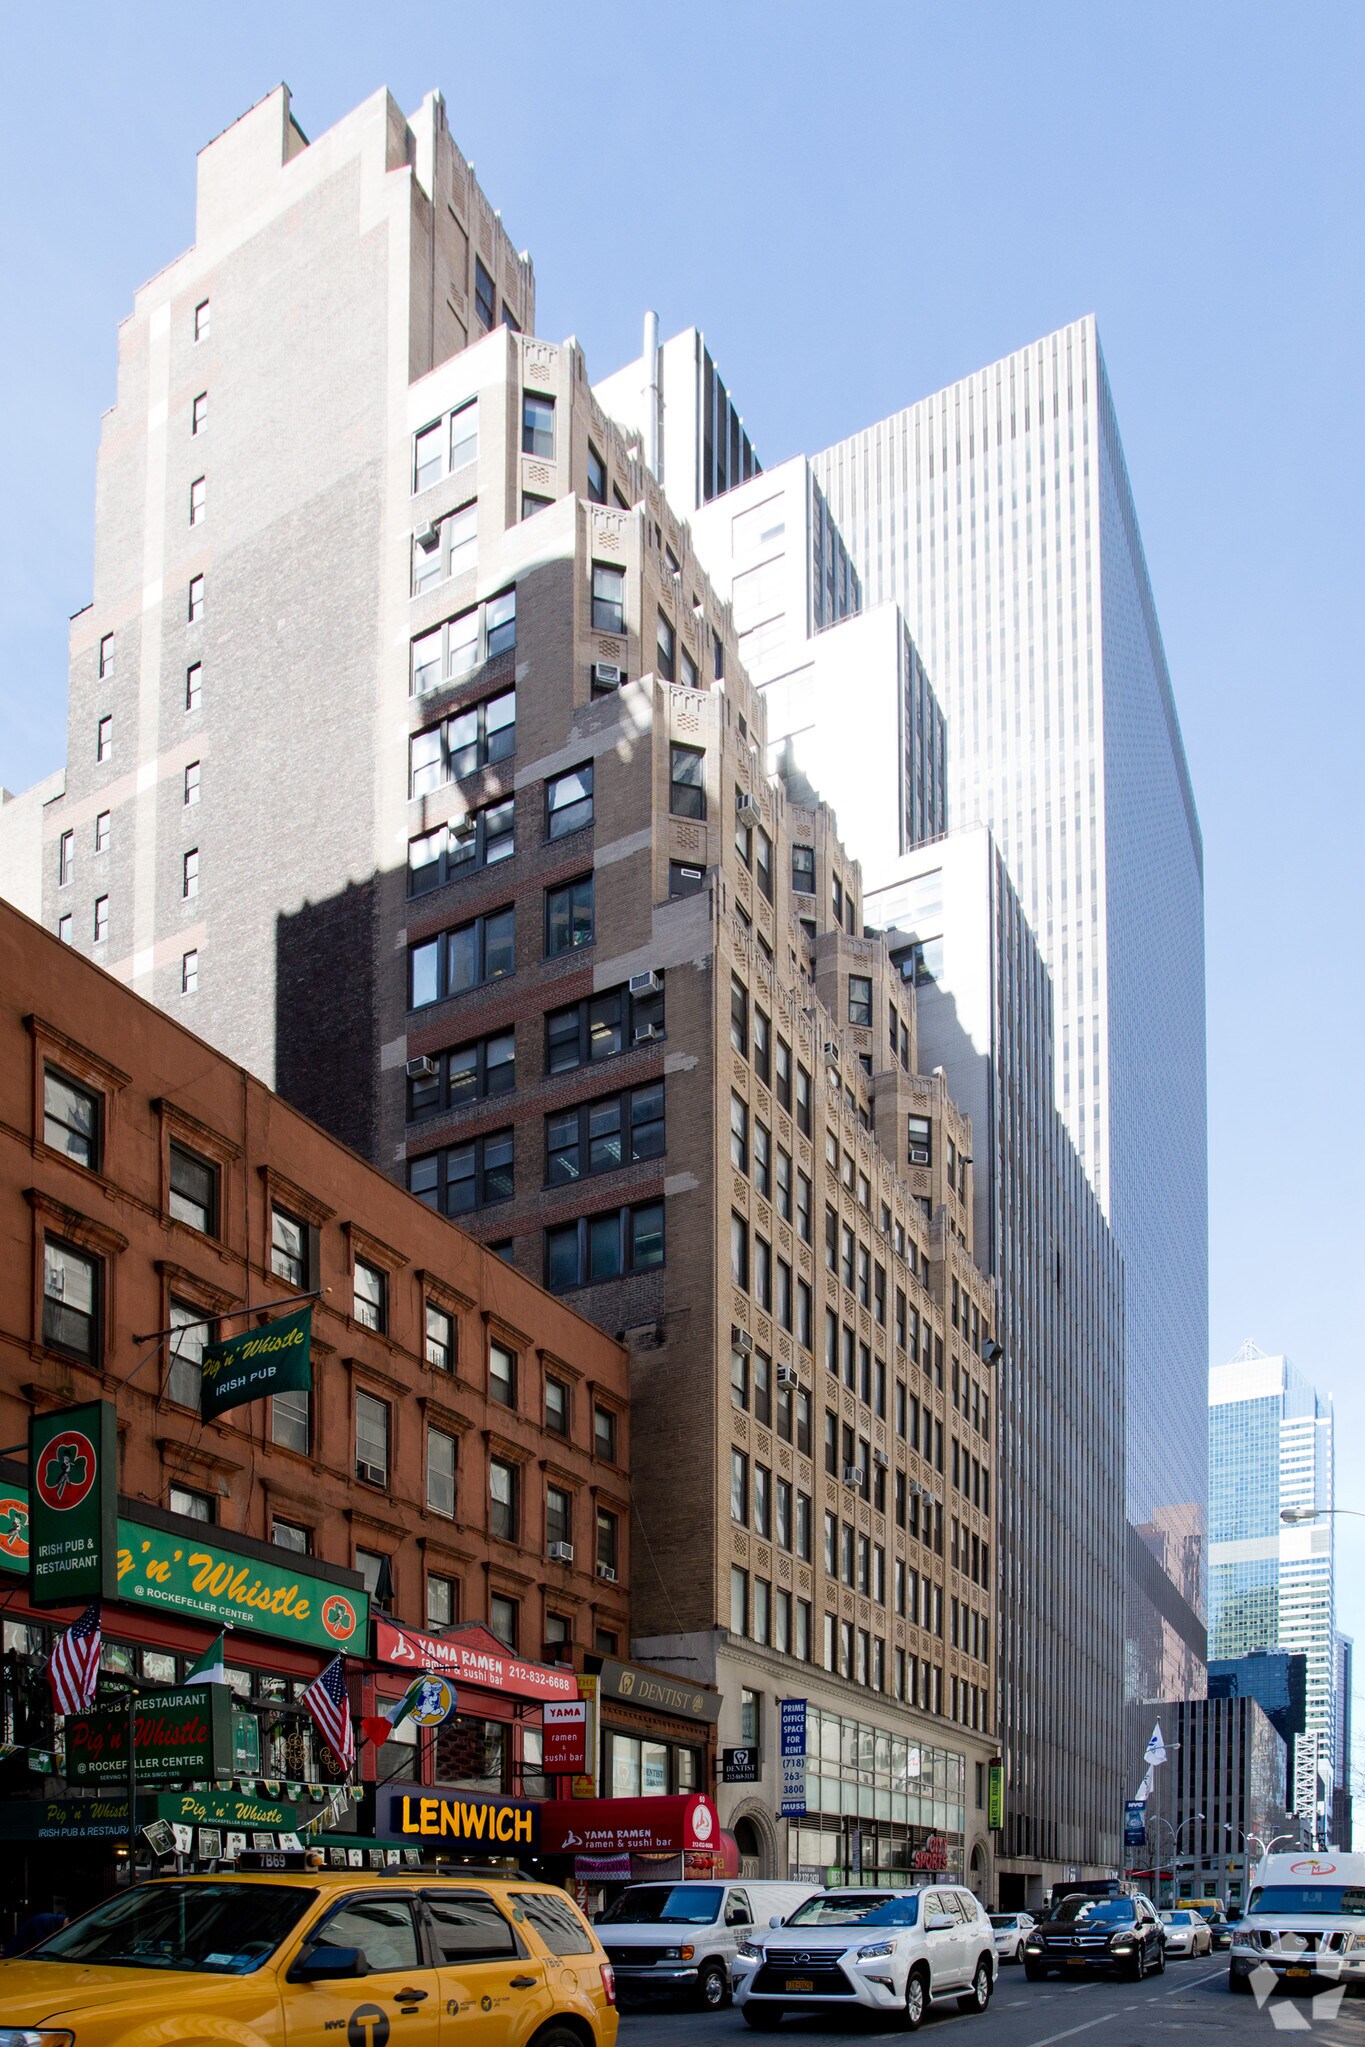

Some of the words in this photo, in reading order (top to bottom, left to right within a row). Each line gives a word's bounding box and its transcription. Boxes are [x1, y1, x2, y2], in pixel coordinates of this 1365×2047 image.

[202, 1359, 221, 1380] Pig
[242, 1328, 305, 1360] Whistle
[216, 1375, 246, 1396] IRISH
[250, 1366, 277, 1382] PUB
[39, 1543, 63, 1557] IRISH
[65, 1540, 84, 1553] PUB
[87, 1538, 94, 1549] &
[36, 1555, 98, 1575] RESTAURANT
[188, 1553, 310, 1620] Whistle
[134, 1585, 145, 1597] @
[146, 1588, 217, 1613] ROCKEFELLER
[219, 1606, 254, 1622] CENTER
[418, 1638, 458, 1663] YAMA
[461, 1650, 503, 1674] RAMEN
[509, 1665, 570, 1691] 212-832-6688
[453, 1665, 461, 1675] &
[464, 1668, 487, 1682] sushi
[489, 1674, 504, 1686] bar
[135, 1694, 207, 1710] RESTAURANT
[638, 1681, 691, 1709] DENTIST
[550, 1708, 581, 1718] YAMA
[783, 1704, 805, 1712] PRIME
[783, 1714, 805, 1723] OFFICE
[783, 1725, 804, 1733] SPACE
[72, 1720, 105, 1759] Pig
[134, 1715, 208, 1748] Whistle
[551, 1734, 577, 1742] ramen
[787, 1735, 800, 1743] FOR
[544, 1753, 567, 1762] sushi
[569, 1753, 583, 1761] bar
[785, 1746, 802, 1754] RENT
[77, 1763, 87, 1775] @
[89, 1758, 159, 1772] ROCKEFLLER
[162, 1755, 204, 1767] CENTER
[726, 1764, 756, 1773] DENTIST
[782, 1758, 805, 1769] (718)
[784, 1772, 803, 1781] 263-
[991, 1768, 999, 1797] AVAILABLE
[783, 1785, 804, 1794] 3800
[46, 1803, 67, 1823] Pig
[90, 1802, 130, 1820] Whistl
[181, 1797, 206, 1821] Pig
[235, 1802, 283, 1824] Whistle
[782, 1802, 806, 1810] MUSS
[991, 1798, 999, 1817] RETAIL
[208, 1818, 241, 1826] ROCKEFELLER
[402, 1795, 532, 1844] LENWICH
[38, 1826, 59, 1838] IRISH
[60, 1826, 78, 1837] PUB
[79, 1825, 87, 1836] &
[584, 1830, 614, 1839] YAMA
[616, 1829, 651, 1838] RAMEN
[585, 1839, 614, 1848] ramen
[617, 1839, 624, 1848] &
[627, 1838, 653, 1848] sushi
[656, 1837, 672, 1847] bar
[928, 1836, 949, 1854] CITY
[259, 1853, 286, 1868] 7B69
[914, 1850, 948, 1871] SPORTS
[324, 2019, 346, 2031] NYC
